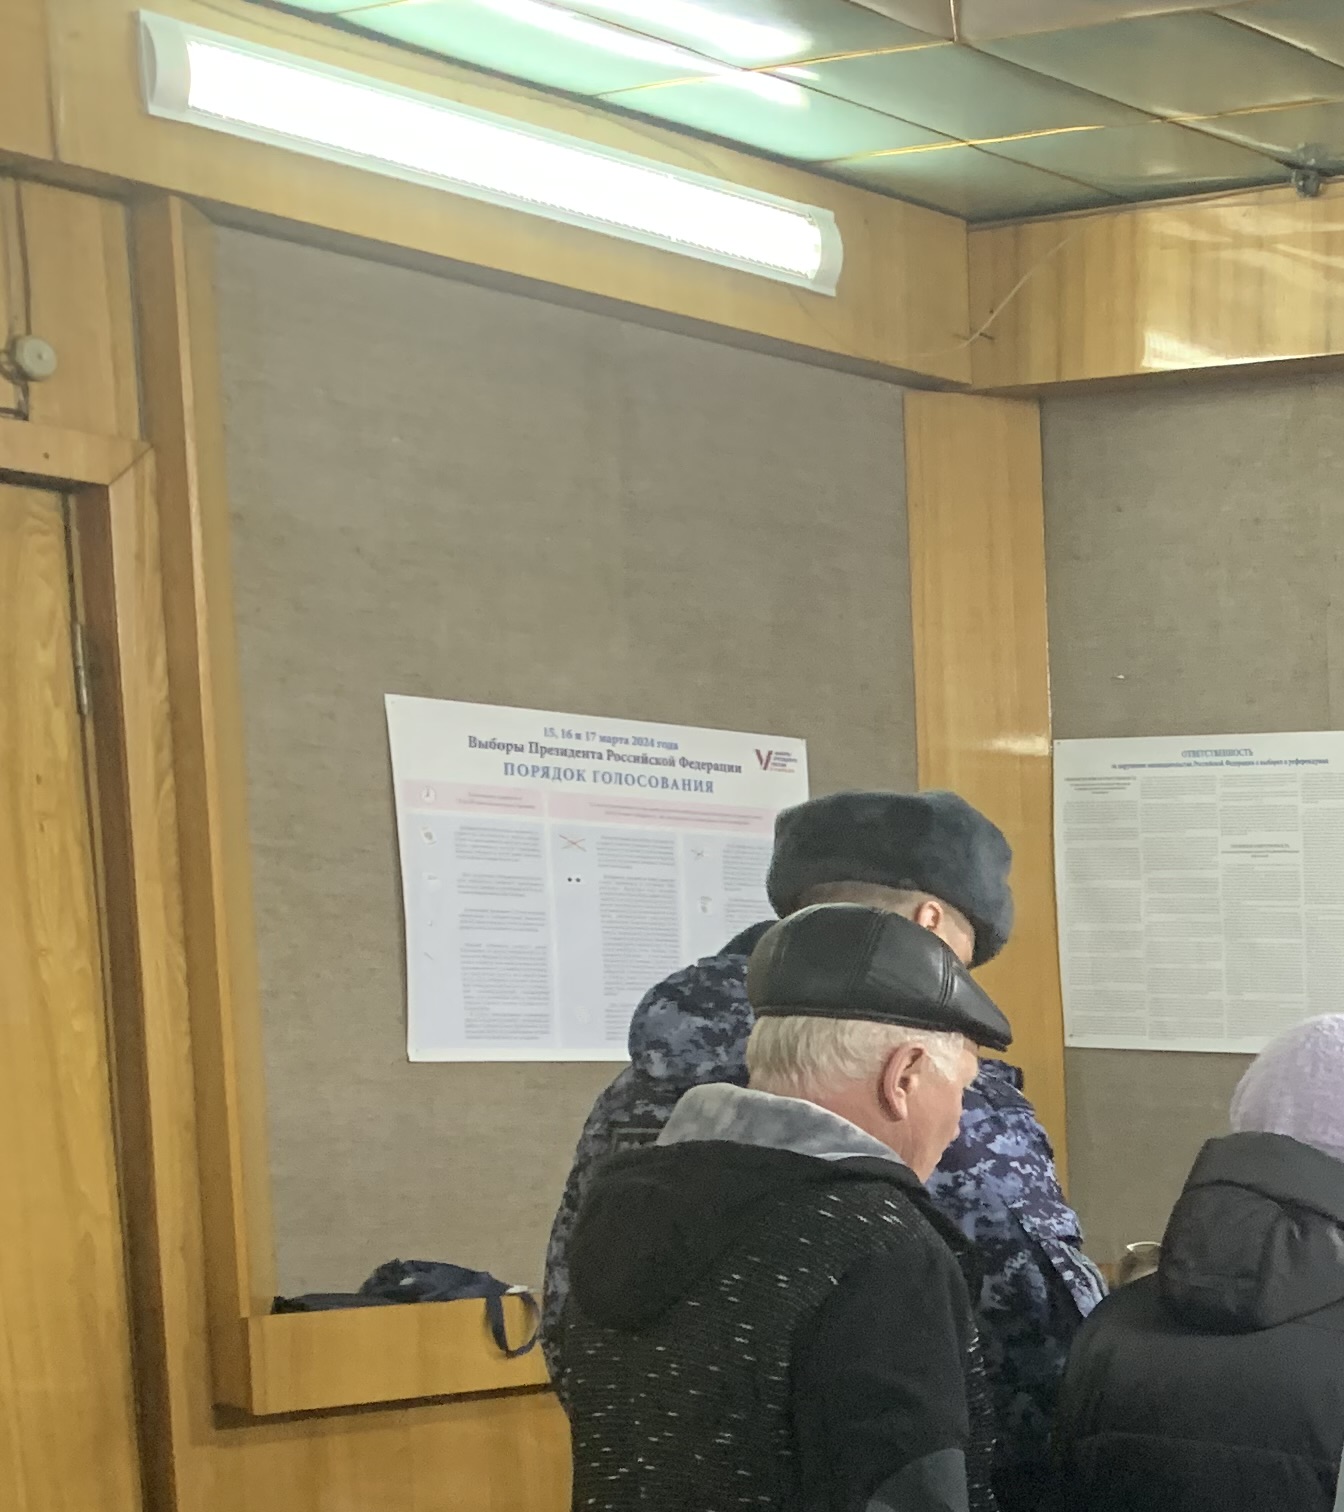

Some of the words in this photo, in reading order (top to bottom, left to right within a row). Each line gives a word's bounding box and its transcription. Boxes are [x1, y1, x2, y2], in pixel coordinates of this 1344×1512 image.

[561, 729, 573, 739] 16
[585, 731, 597, 741] 17
[599, 734, 629, 746] марта
[632, 736, 655, 747] 2024
[468, 736, 524, 755] Выборы
[528, 742, 603, 760] Президента
[607, 749, 676, 766] Российской
[679, 757, 742, 774] Федерации
[503, 762, 586, 782] ПОРЯДОК
[593, 770, 714, 793] ГОЛОСОВАНИЯ
